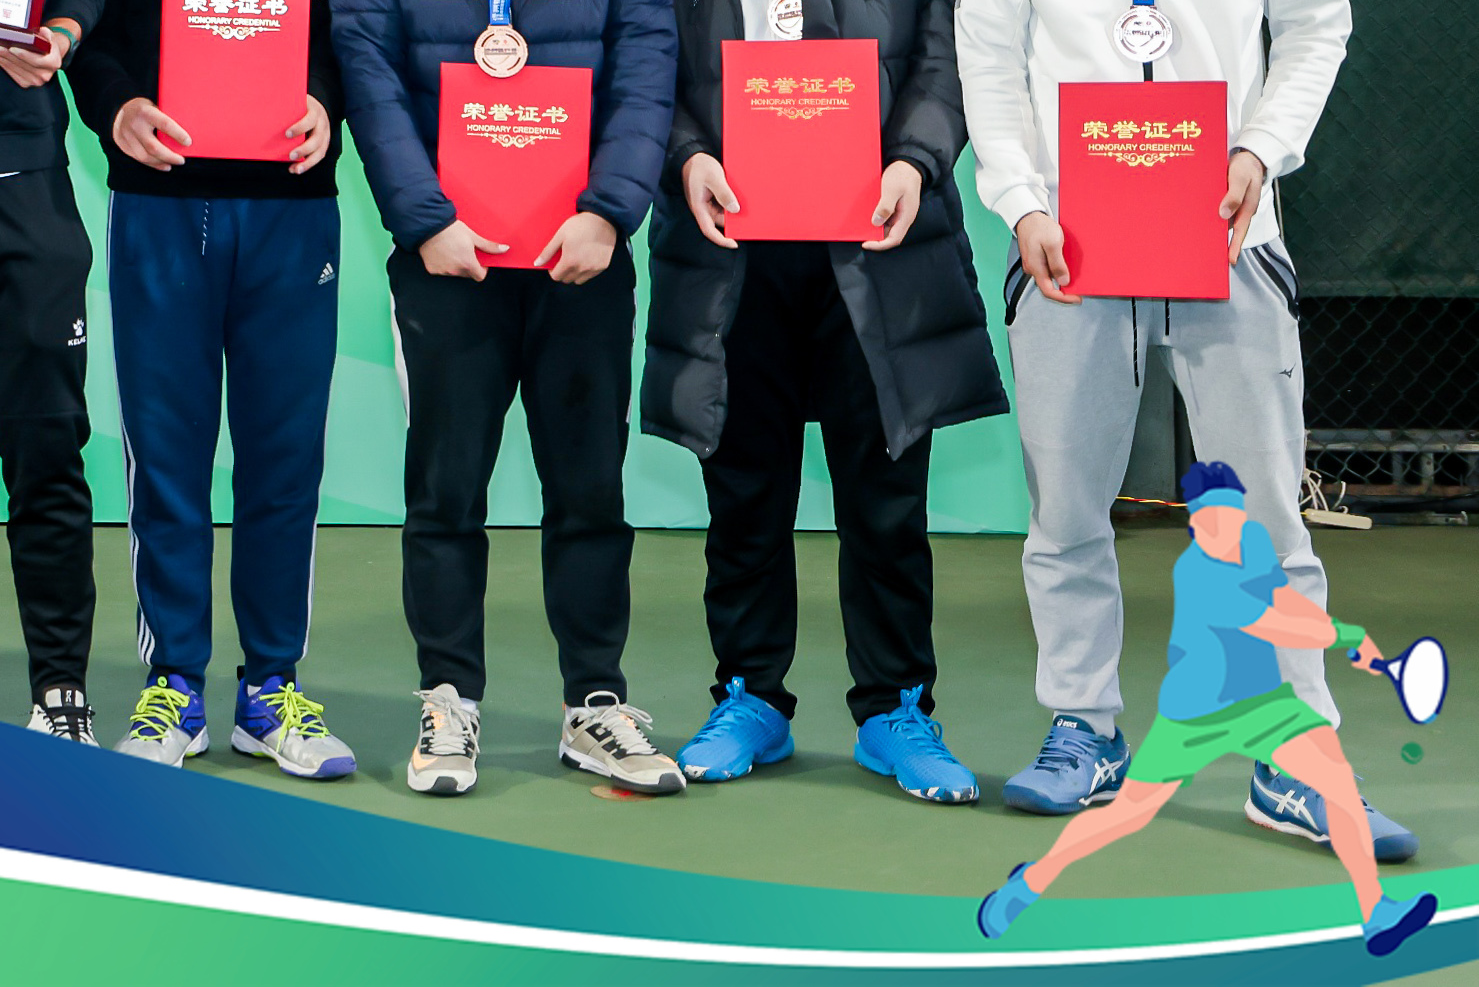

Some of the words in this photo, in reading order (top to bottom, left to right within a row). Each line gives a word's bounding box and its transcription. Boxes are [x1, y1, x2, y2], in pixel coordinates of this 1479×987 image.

[188, 16, 232, 26] HONORARY
[233, 18, 280, 27] CREDENTIAL
[745, 78, 855, 93] 荣誉证书
[798, 98, 849, 106] CREDENTIAL
[461, 102, 568, 124] 荣誉证书
[467, 124, 511, 133] HONORARY
[513, 126, 561, 135] CREDENTIAL
[1081, 121, 1202, 139] 荣誉证书
[1088, 144, 1138, 152] HONORARY
[1139, 144, 1195, 152] CREDENTIAL
